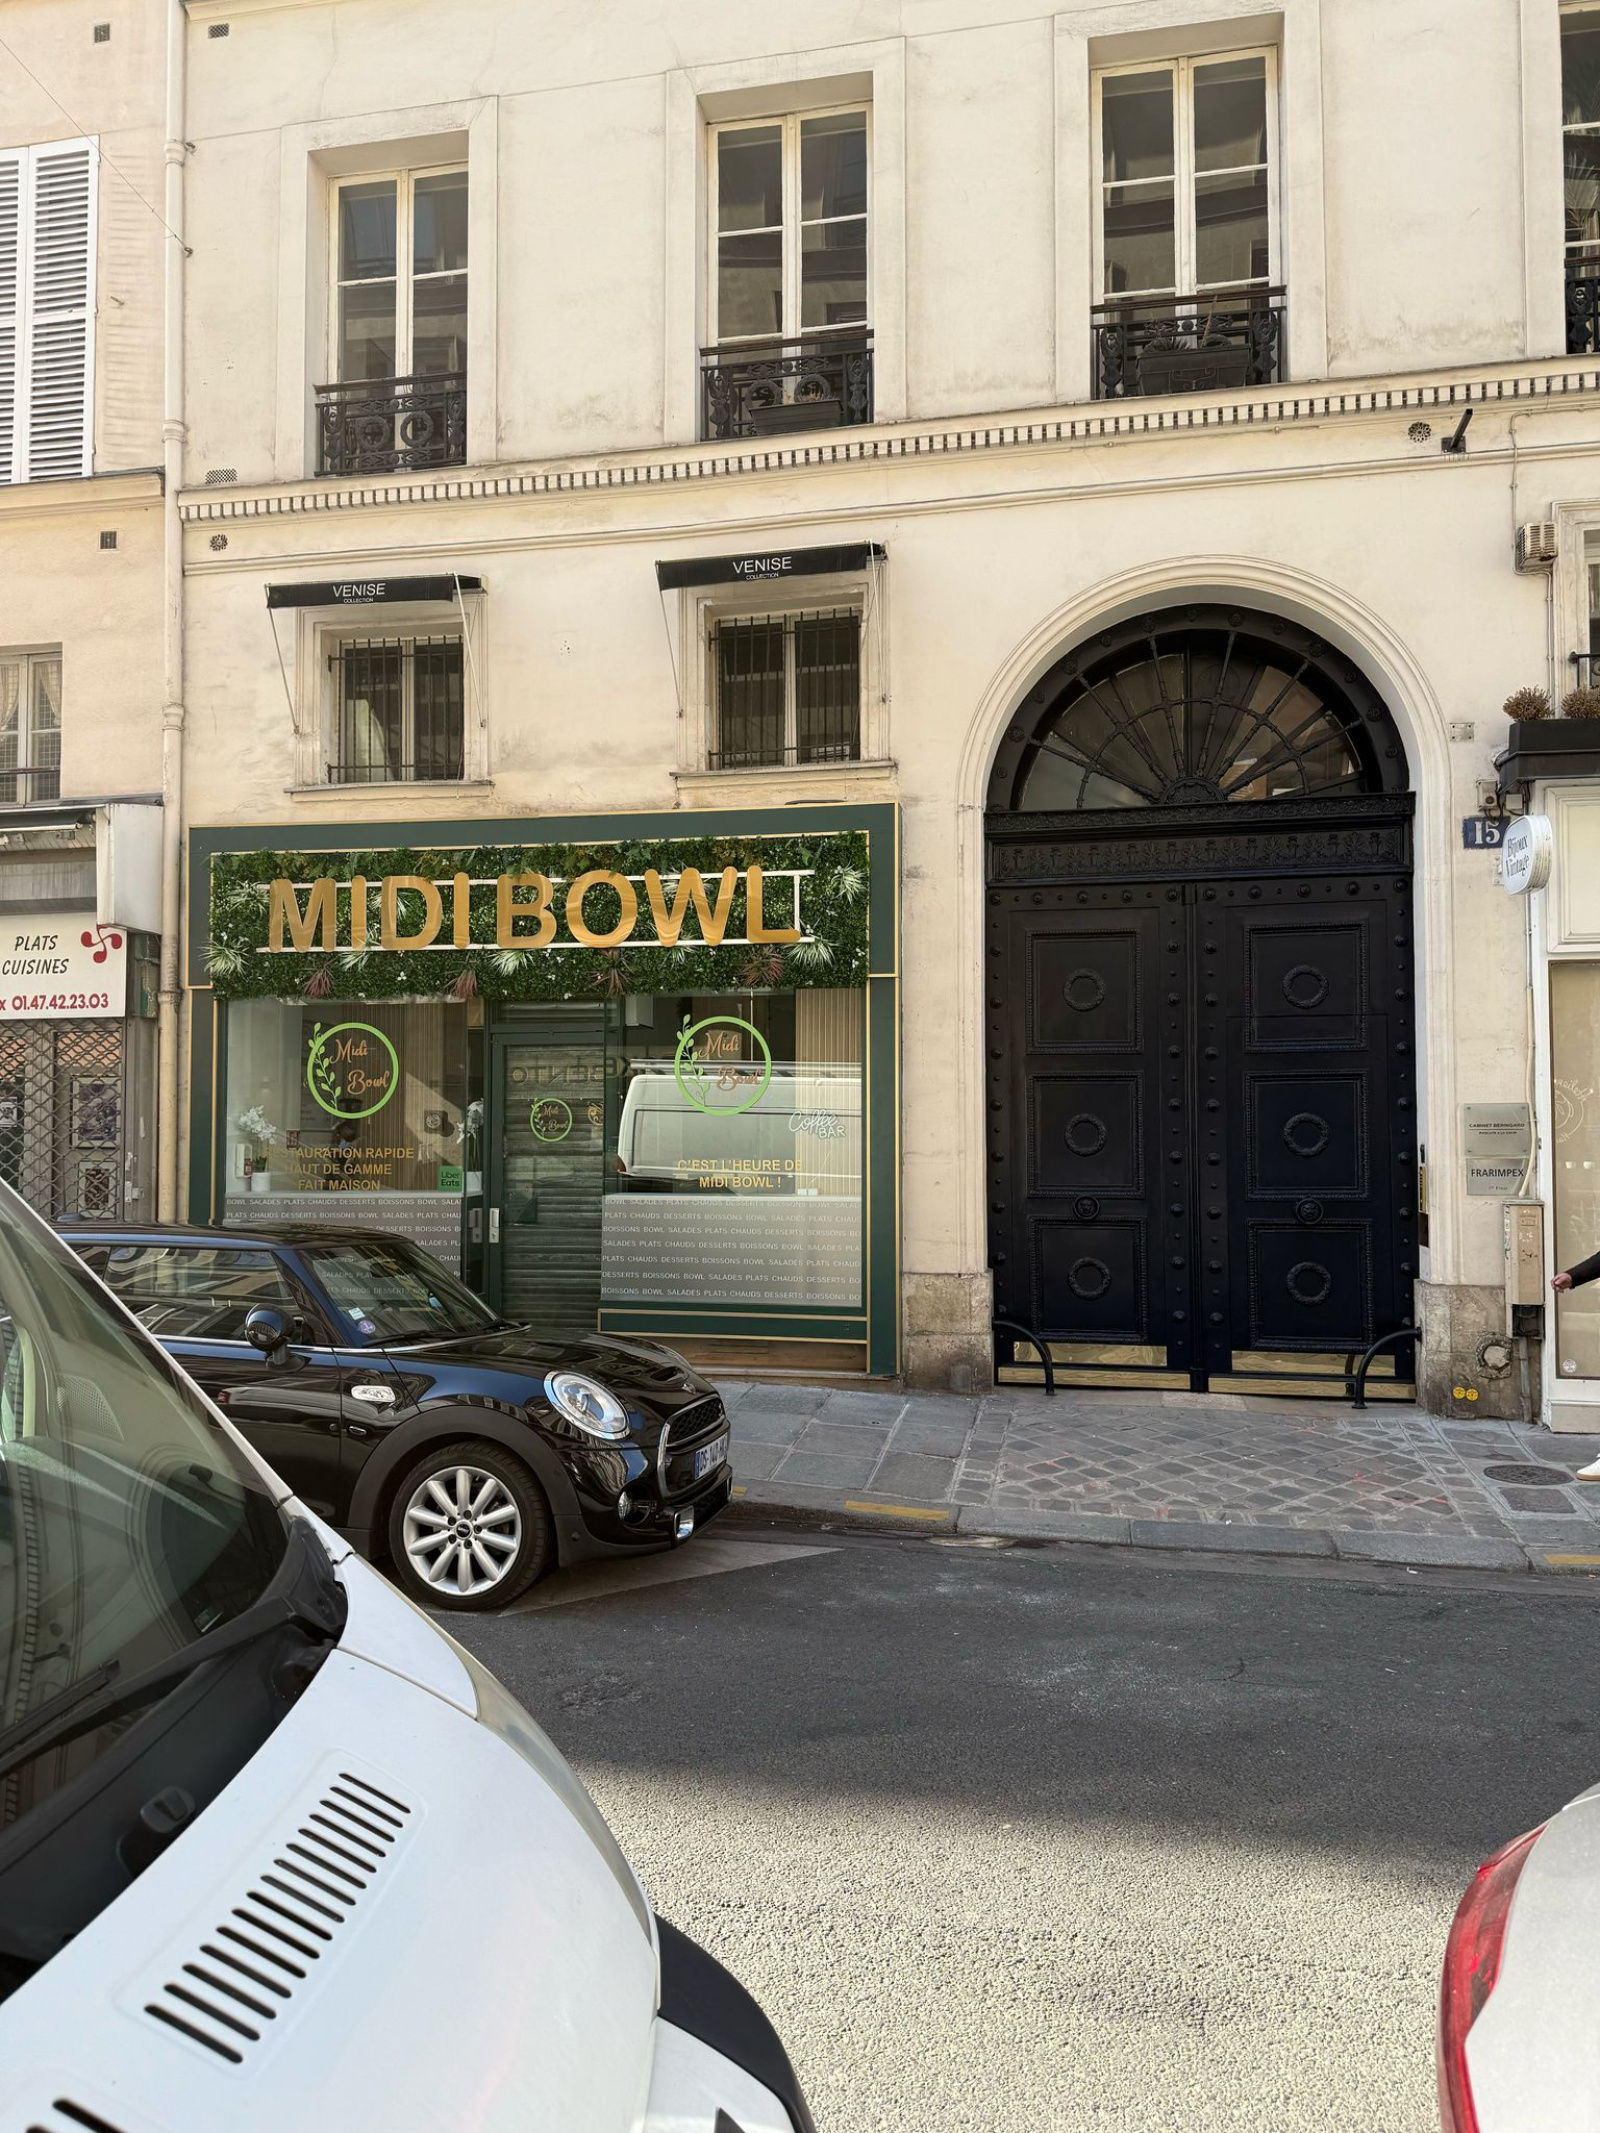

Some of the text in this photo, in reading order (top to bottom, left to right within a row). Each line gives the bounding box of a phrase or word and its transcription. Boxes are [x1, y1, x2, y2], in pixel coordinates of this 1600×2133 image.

[732, 556, 792, 574] VENISE
[332, 583, 386, 597] VENISE
[1474, 821, 1500, 844] 15
[269, 865, 801, 954] MIDI BOWL
[14, 935, 59, 951] PLATS
[2, 958, 69, 976] CUISINES
[12, 993, 109, 1011] 01.47.42.23.03
[329, 1038, 368, 1064] Midi
[699, 1031, 740, 1058] Midi
[347, 1069, 390, 1095] Bowl
[716, 1066, 762, 1091] Bowl
[788, 1108, 838, 1134] Coffee
[818, 1125, 846, 1139] BAR
[365, 1147, 415, 1159] RAPIDE
[284, 1163, 393, 1175] HAUT DE GAMME
[677, 1159, 802, 1172] C'EST L'HEURE DE
[441, 1171, 460, 1179] Uber
[1471, 1168, 1524, 1178] FRARIMPEX
[298, 1179, 381, 1191] FAIT MAISON
[441, 1179, 460, 1187] Eats
[699, 1176, 729, 1188] MIDI
[733, 1176, 774, 1188] BOWL
[602, 1225, 641, 1233] BOISSONS
[764, 1228, 804, 1236] DESSERTS
[602, 1239, 637, 1247] SALADES
[639, 1240, 662, 1248] PLATS
[698, 1241, 737, 1249] DESSERTS
[627, 1255, 658, 1263] CHAUDS
[660, 1256, 700, 1264] DESSERTS
[601, 1270, 640, 1278] DESSERTS
[683, 1272, 706, 1280] BOWL
[708, 1273, 743, 1281] SALADES
[806, 1276, 846, 1284] DESSERTS
[601, 1286, 640, 1295] BOISSONS
[642, 1287, 664, 1296] BOWL
[667, 1288, 702, 1297] SALADES
[703, 1289, 727, 1297] PLATS
[729, 1290, 761, 1298] CHAUDS
[764, 1291, 803, 1299] DESSERTS
[806, 1292, 846, 1300] BOISSONS
